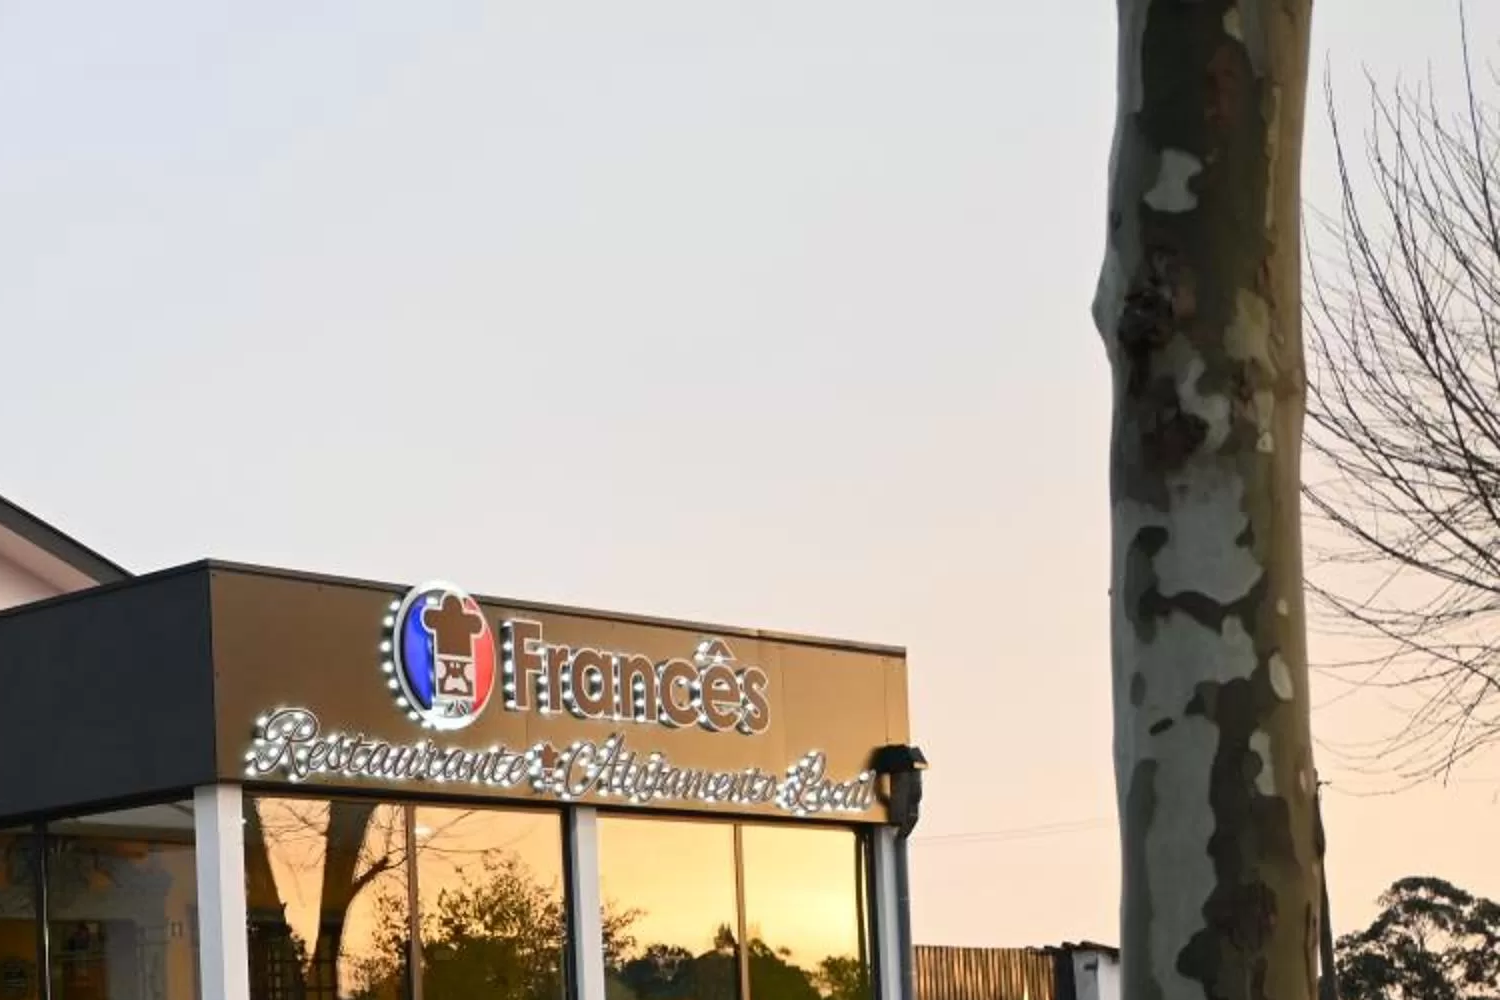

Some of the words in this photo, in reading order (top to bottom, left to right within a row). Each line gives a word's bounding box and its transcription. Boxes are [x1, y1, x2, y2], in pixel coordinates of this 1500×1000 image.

[503, 618, 770, 734] Francês
[247, 707, 528, 781] Restaurante
[560, 732, 777, 802] Alojamento
[780, 751, 876, 814] Local
